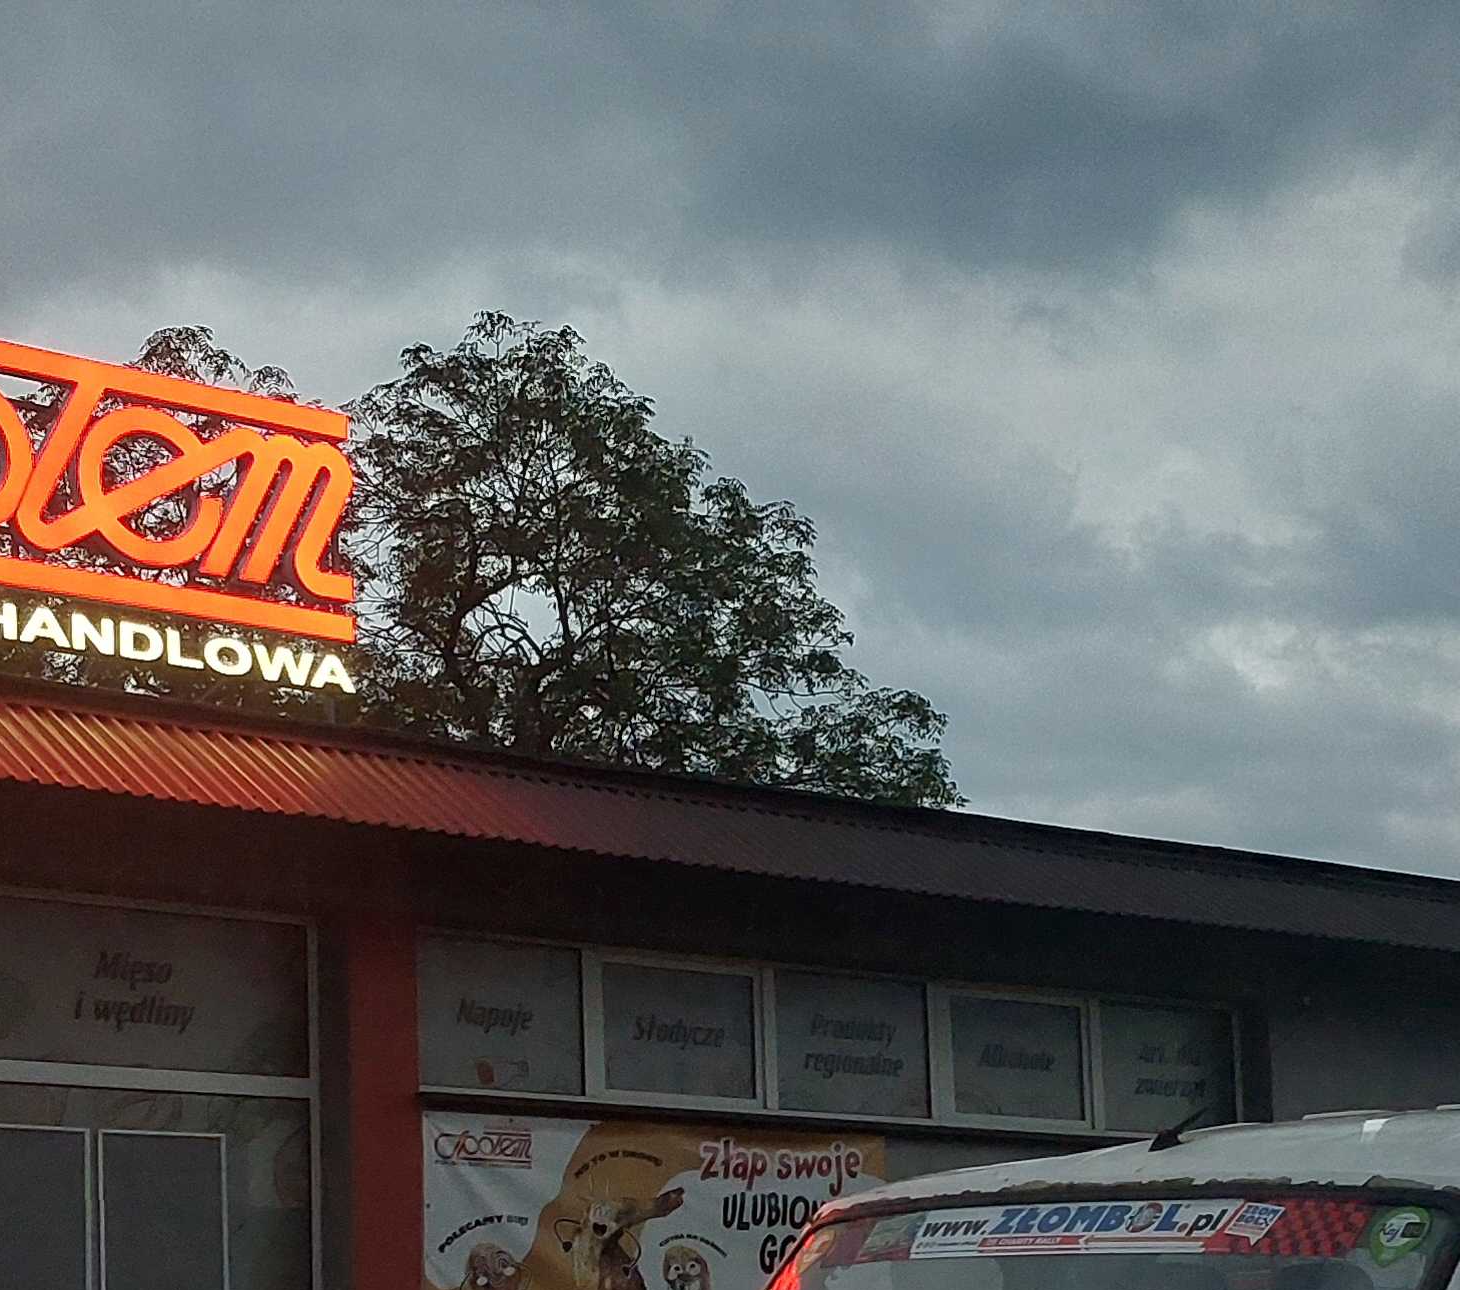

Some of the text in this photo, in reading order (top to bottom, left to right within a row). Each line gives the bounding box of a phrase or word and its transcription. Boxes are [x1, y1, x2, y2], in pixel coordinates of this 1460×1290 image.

[457, 999, 533, 1036] Napoje
[633, 1015, 725, 1050] Słodycze
[804, 1049, 903, 1080] regionalne
[700, 1137, 861, 1196] Złap swoje
